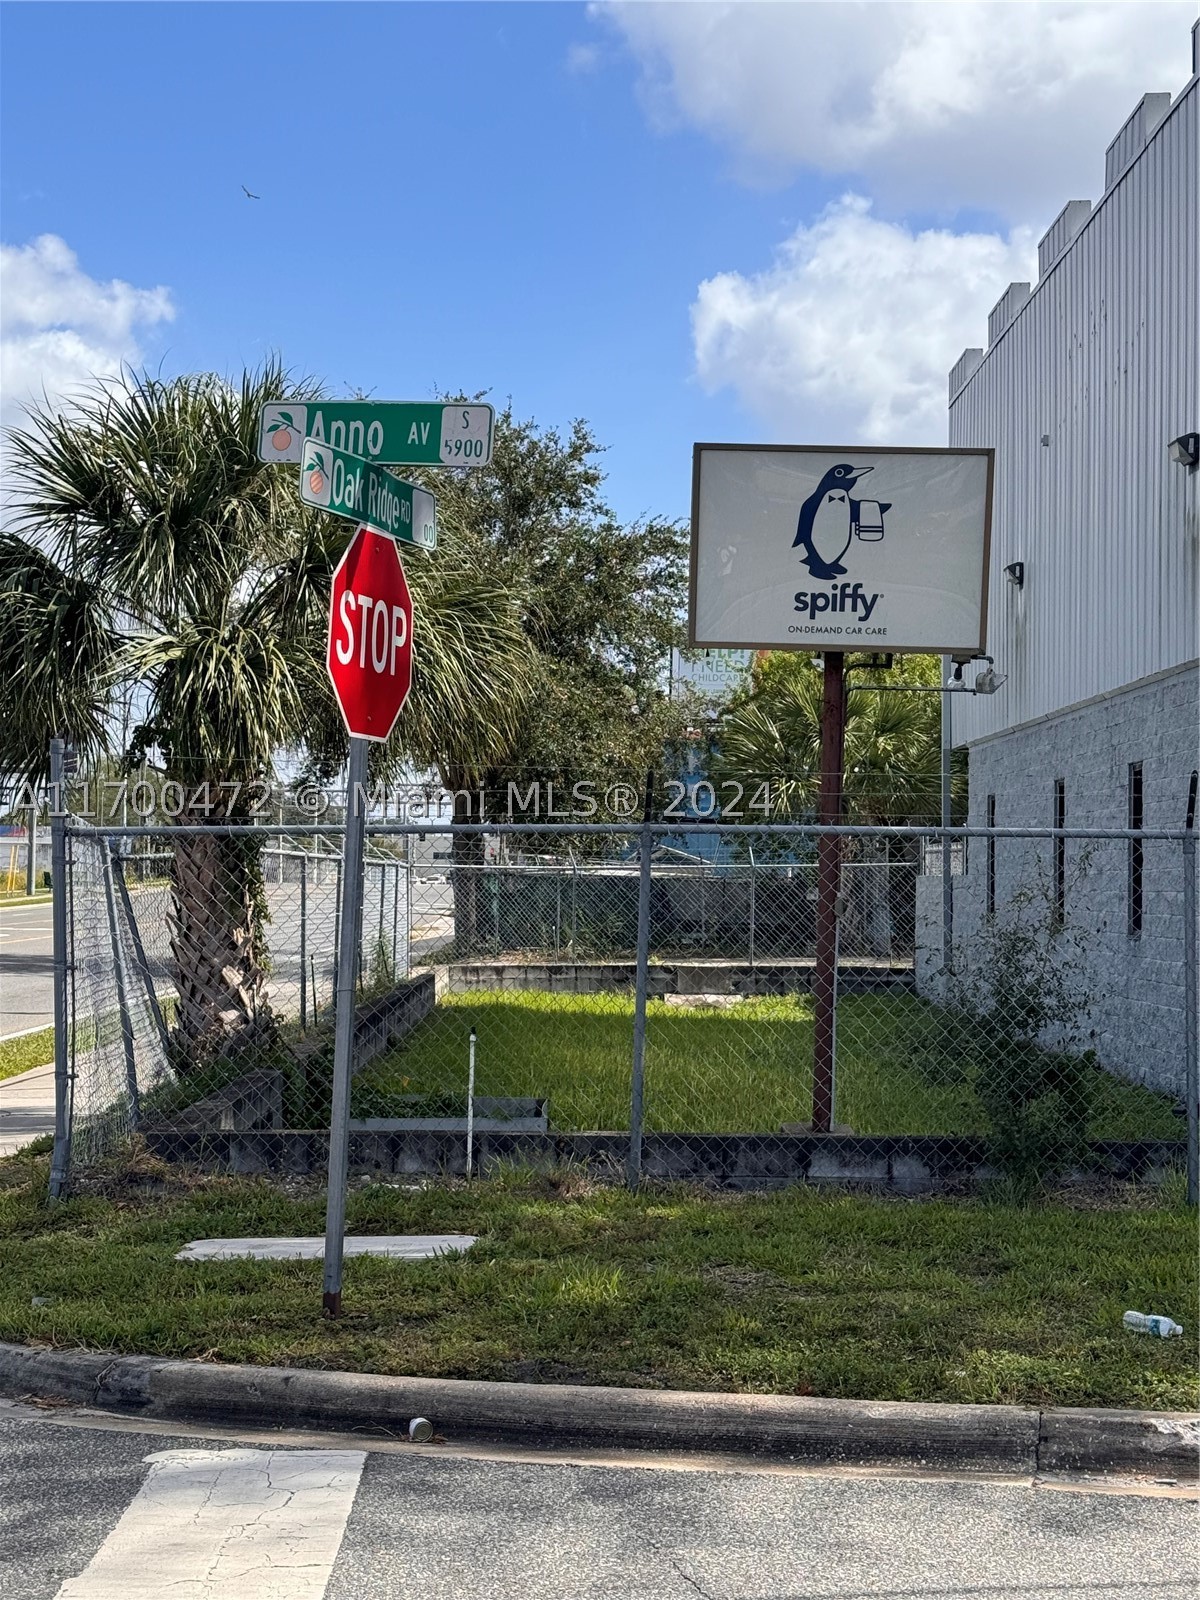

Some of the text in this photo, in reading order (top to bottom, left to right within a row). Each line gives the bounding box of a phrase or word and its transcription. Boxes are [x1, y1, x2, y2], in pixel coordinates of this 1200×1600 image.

[310, 410, 431, 455] Anno AV
[462, 410, 470, 429] S
[444, 439, 483, 458] 5900
[332, 458, 411, 532] Oak Ridge RD
[793, 582, 879, 622] spiffy
[335, 589, 407, 676] STOP
[787, 625, 888, 636] ON-DEMAND CAR CARE
